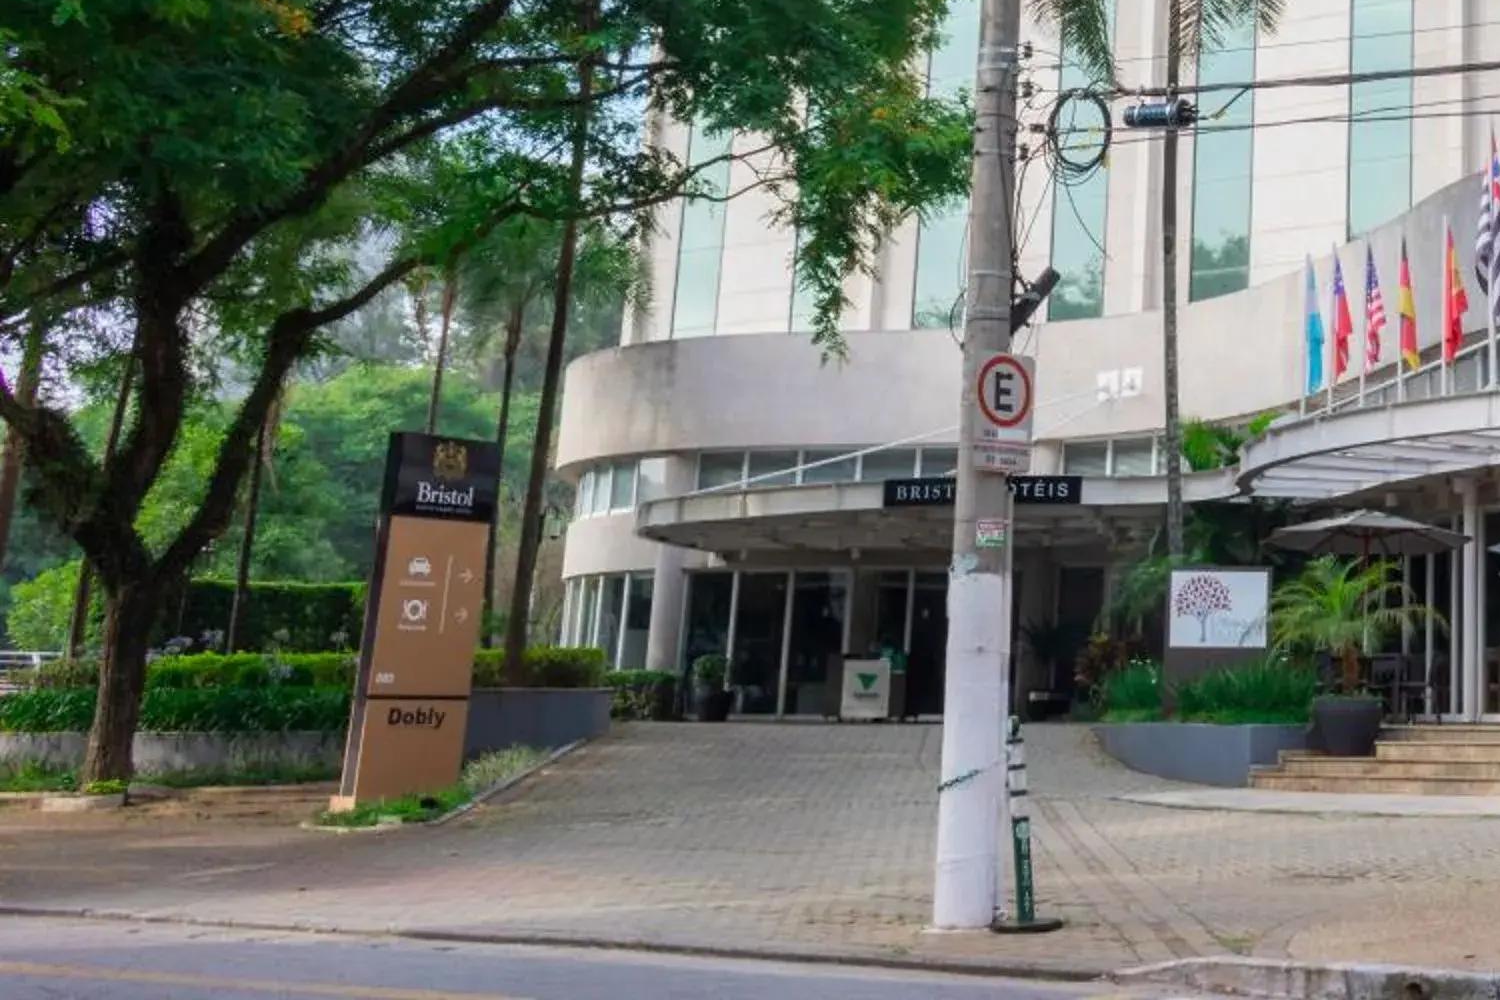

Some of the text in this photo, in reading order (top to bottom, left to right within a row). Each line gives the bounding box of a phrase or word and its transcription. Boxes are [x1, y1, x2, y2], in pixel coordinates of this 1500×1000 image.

[994, 371, 1013, 412] E
[416, 481, 474, 507] Bristol
[896, 484, 956, 500] BRIST
[387, 706, 446, 730] Dobly
